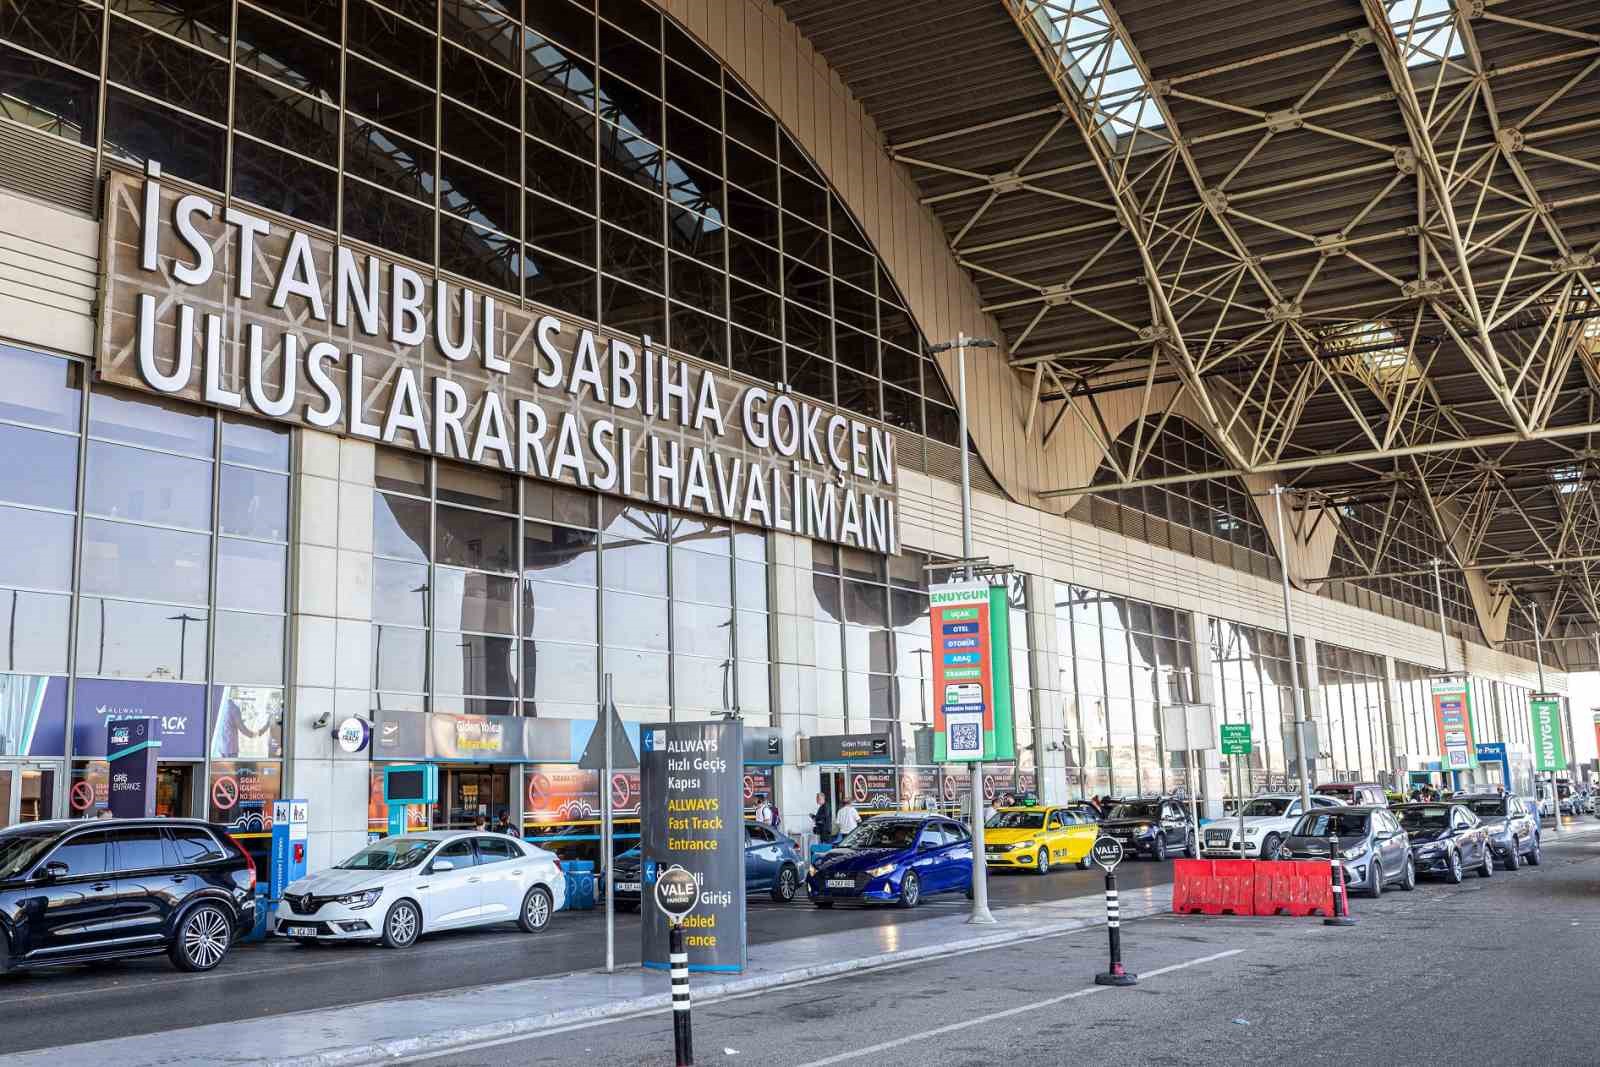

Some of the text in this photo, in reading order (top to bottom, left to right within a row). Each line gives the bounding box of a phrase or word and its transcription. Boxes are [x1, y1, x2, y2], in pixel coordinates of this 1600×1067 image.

[140, 159, 894, 488] İSTANBUL SABİHA GÖKÇEN
[137, 294, 895, 554] ULUSLARARASI HAVALİMANI
[931, 590, 988, 602] ENUYGUN
[952, 655, 972, 663] ARAÇ
[1539, 706, 1556, 767] ENUYGUN
[667, 740, 718, 752] ALLWAYS
[668, 757, 727, 773] Hızlı Geçiş
[113, 782, 141, 791] ENTRANCE
[668, 776, 700, 792] Kapısı
[668, 799, 719, 811] ALLWAYS
[668, 815, 723, 829] Fast Track
[668, 838, 718, 850] Entrance
[1095, 845, 1119, 855] VALE
[660, 882, 694, 896] VALE
[701, 891, 731, 907] Girişi
[685, 935, 716, 946] rance
